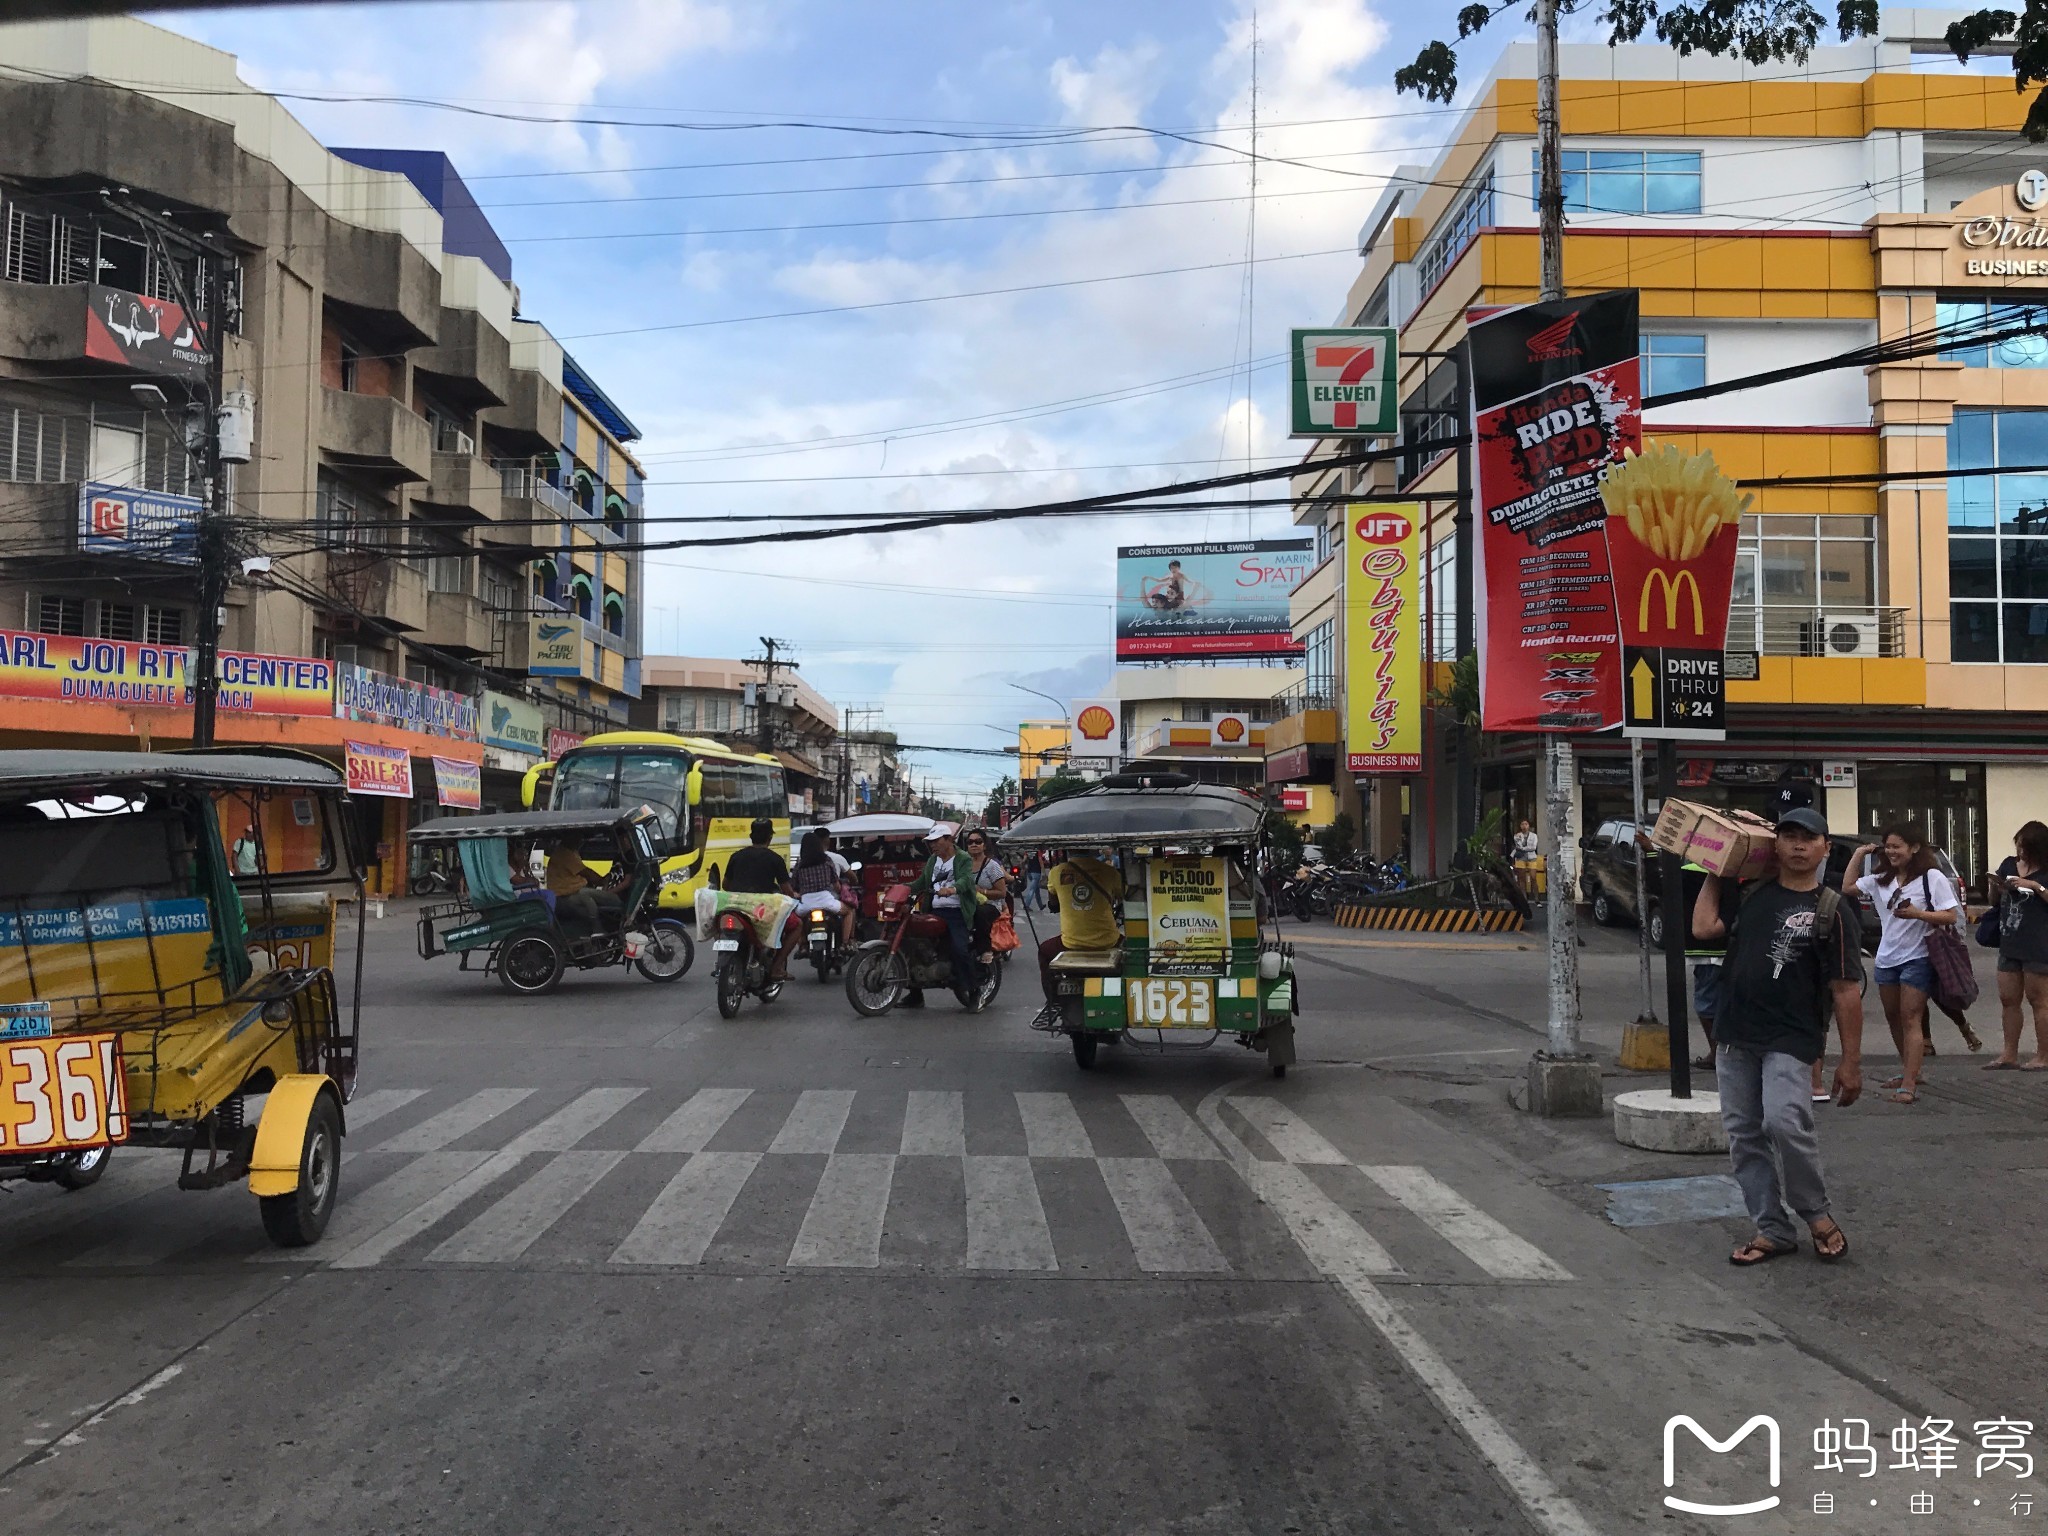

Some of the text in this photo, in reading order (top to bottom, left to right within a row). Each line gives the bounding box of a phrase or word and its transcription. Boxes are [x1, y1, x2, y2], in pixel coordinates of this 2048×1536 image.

[1527, 347, 1584, 363] HONDA
[1516, 400, 1595, 450] RIDE
[1548, 466, 1564, 479] AT
[1491, 473, 1595, 523] DUMAGUETE
[1360, 518, 1408, 538] JFT
[1128, 546, 1192, 556] CONSTRUCTION
[1204, 544, 1225, 552] FULL
[1226, 543, 1255, 552] SWING
[1549, 551, 1589, 560] BEGINNERS
[1549, 575, 1602, 585] INTERMEDIATE
[1549, 598, 1568, 606] OPEN
[1549, 621, 1569, 630] OPEN
[549, 644, 574, 653] CEBU
[1361, 547, 1408, 750] Obdulia's
[1521, 633, 1617, 648] Honda Racing
[536, 651, 572, 660] PACIFIC
[70, 643, 126, 673] JOI
[222, 655, 329, 691] CENTER
[1668, 659, 1718, 676] DRIVE
[62, 677, 176, 704] DUMAGUETE
[1668, 678, 1719, 695] THRU
[344, 674, 404, 718] BAGSAKAN
[407, 690, 420, 721] SA
[1692, 701, 1714, 717] 24
[506, 725, 539, 744] CEBU PACIFIC
[1351, 755, 1418, 766] BUSINESS INN
[348, 757, 388, 783] SALE
[391, 763, 408, 785] 35
[1201, 888, 1223, 896] LOAN?
[87, 907, 119, 922] 2361
[1160, 915, 1219, 929] CEBUANA
[32, 926, 84, 939] DRIVING
[1130, 980, 1210, 1024] 1623
[0, 1040, 123, 1146] 361
